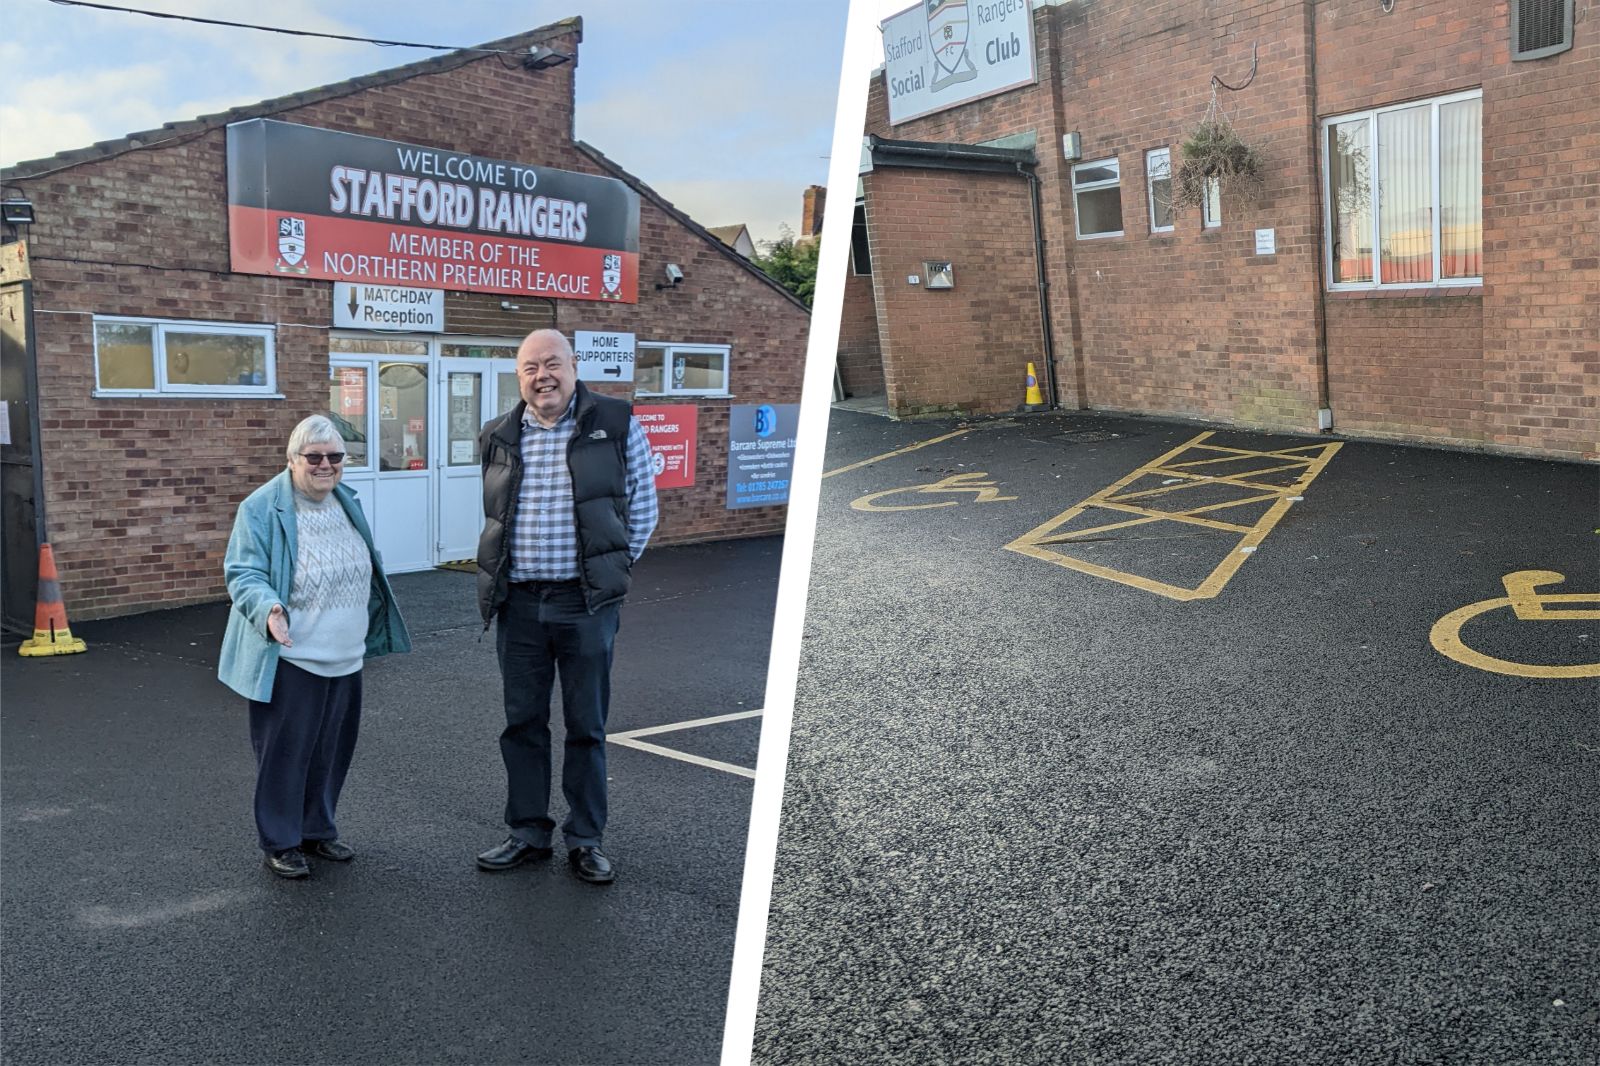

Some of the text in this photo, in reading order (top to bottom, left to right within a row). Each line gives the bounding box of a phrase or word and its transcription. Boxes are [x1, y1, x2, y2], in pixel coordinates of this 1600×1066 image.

[887, 0, 1024, 63] Stafford Rangers
[891, 32, 1021, 99] Social Club
[397, 147, 537, 190] WELCOME TO
[329, 165, 588, 242] STAFFORD RANGERS
[389, 232, 540, 267] MEMBER OF THE
[323, 251, 591, 294] NORTHERN PREMIER LEAGUE
[364, 287, 433, 305] MATCHDAY
[364, 305, 433, 327] Reception
[592, 336, 619, 348] HOME
[576, 350, 634, 363] SUPPORTERS
[650, 425, 679, 433] RANGERS
[730, 440, 757, 451] Barcare
[757, 439, 787, 452] Supreme
